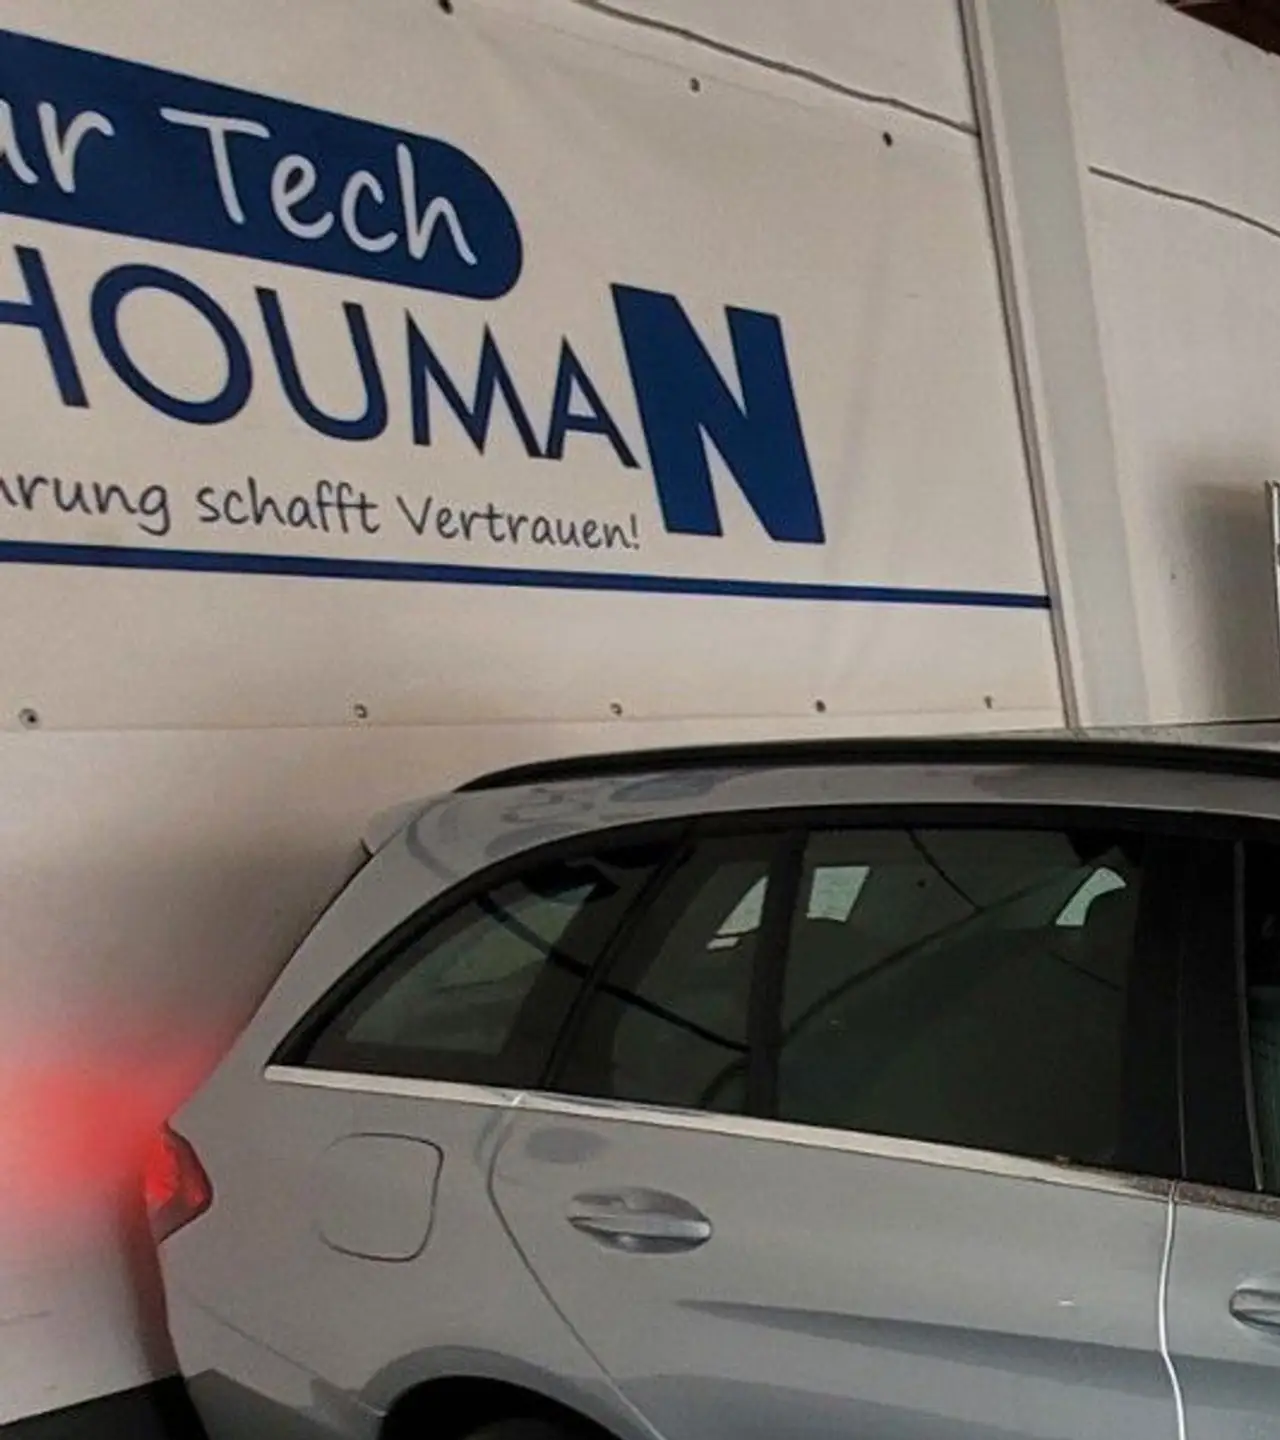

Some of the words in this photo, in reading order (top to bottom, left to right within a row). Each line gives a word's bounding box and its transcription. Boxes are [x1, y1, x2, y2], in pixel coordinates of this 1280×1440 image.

[159, 106, 477, 266] Tech
[195, 476, 382, 535] schafft
[396, 495, 641, 551] Vertrauen!
